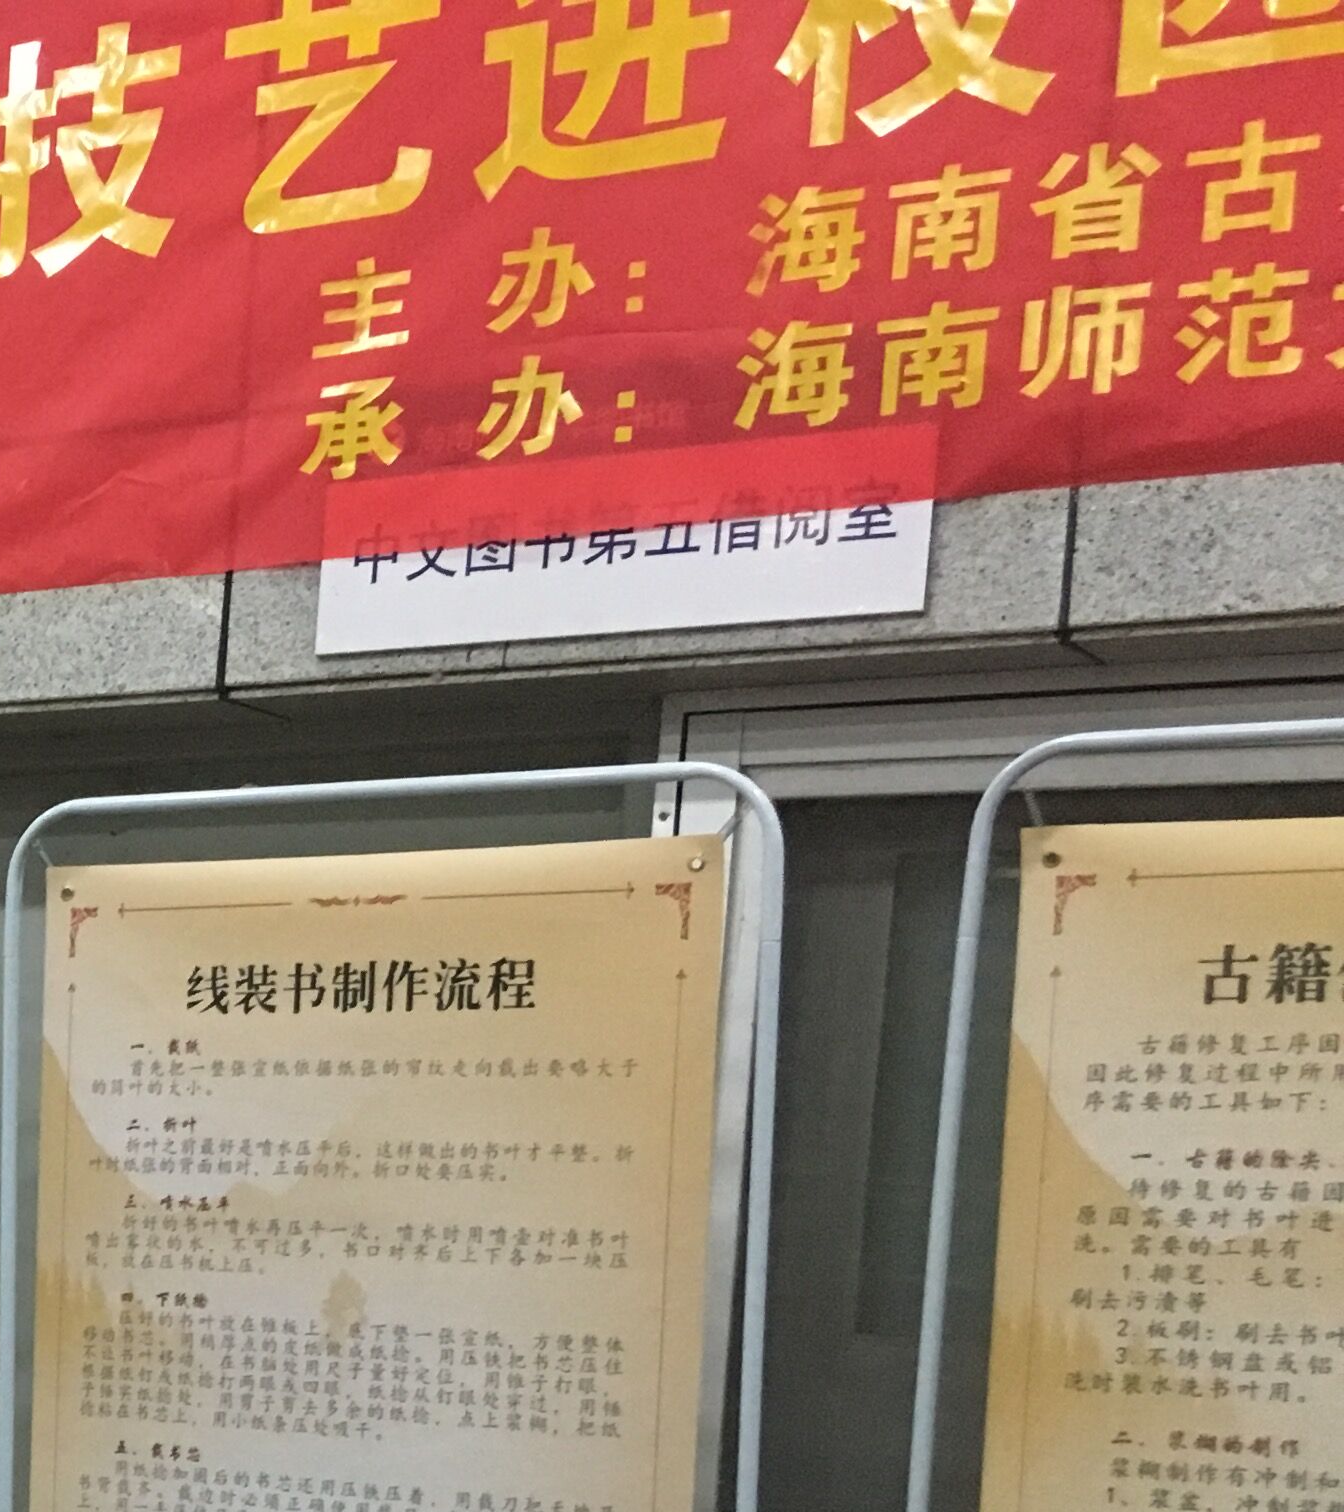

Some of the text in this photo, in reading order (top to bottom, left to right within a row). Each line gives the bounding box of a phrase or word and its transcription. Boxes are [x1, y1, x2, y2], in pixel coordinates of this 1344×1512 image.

[732, 262, 1344, 430] 海南师范
[184, 957, 537, 1015] 线装书制作流程
[1198, 942, 1344, 1005] 古籍
